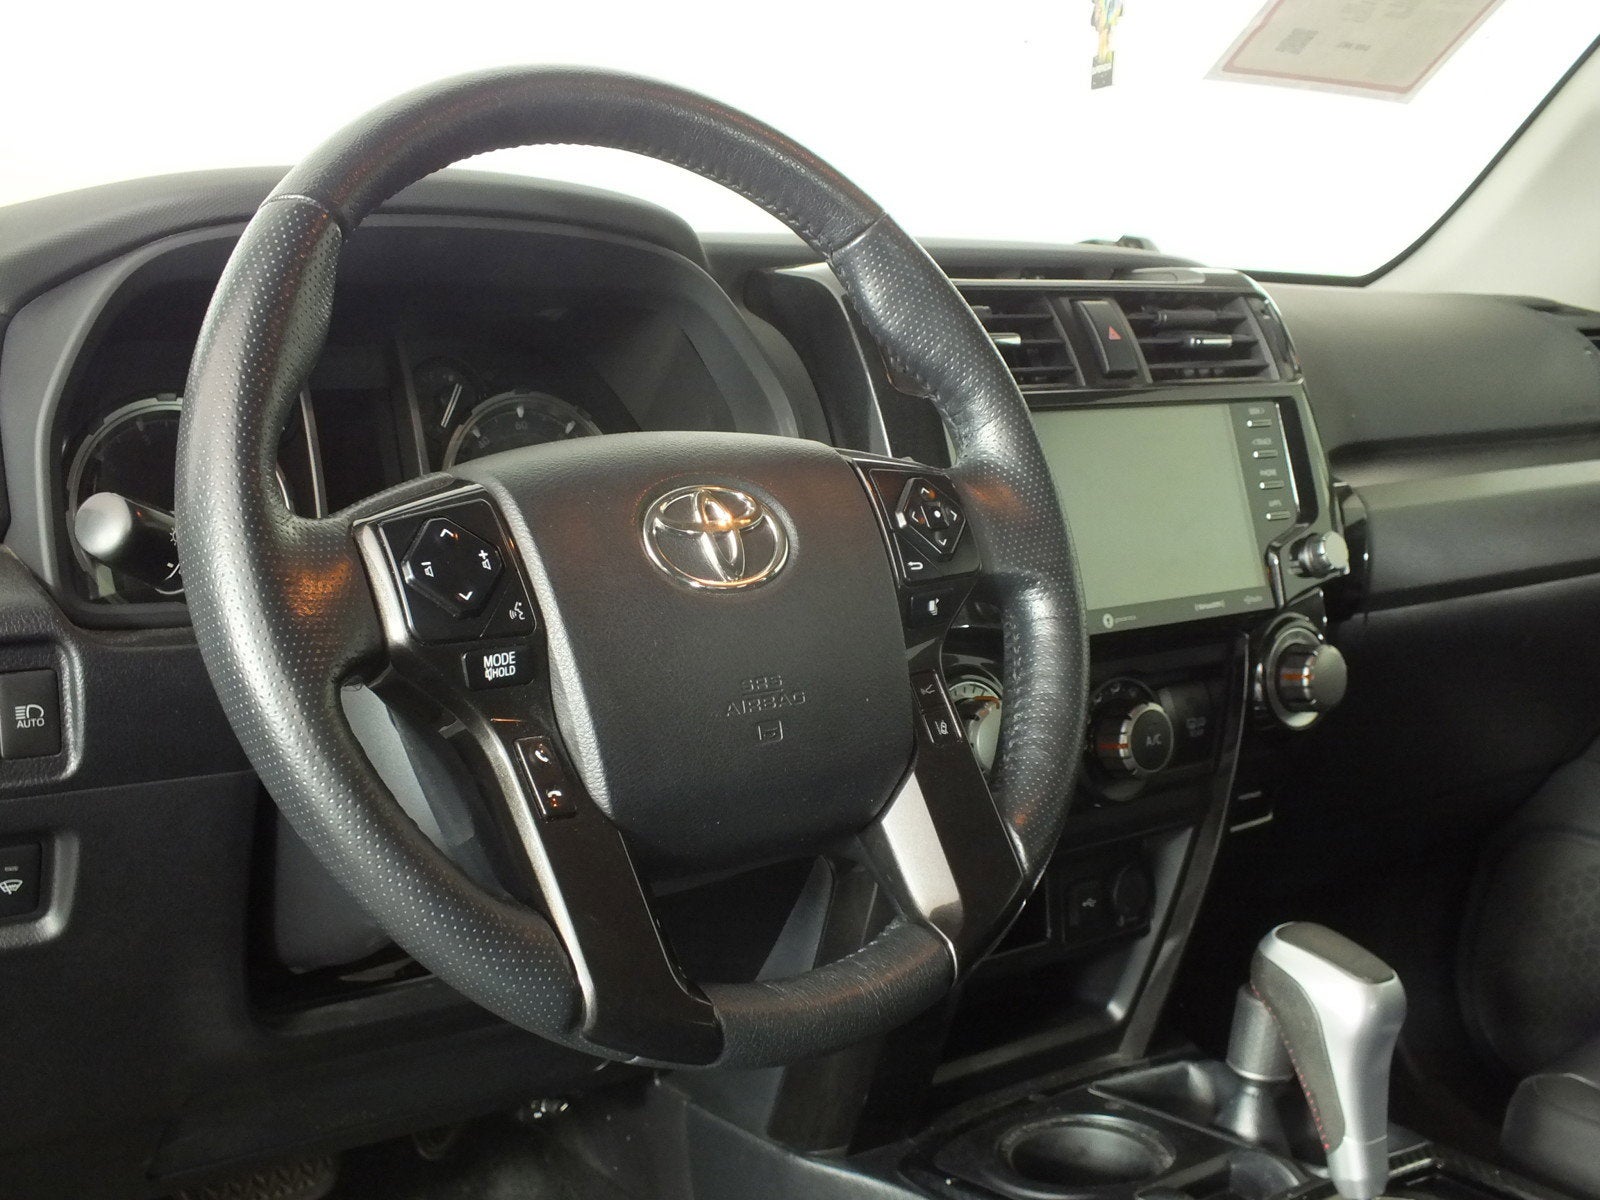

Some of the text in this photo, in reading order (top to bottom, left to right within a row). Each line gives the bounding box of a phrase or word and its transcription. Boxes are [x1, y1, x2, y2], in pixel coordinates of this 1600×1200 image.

[483, 651, 516, 668] MODE
[492, 665, 516, 678] HOLD
[726, 691, 806, 717] AIRBAG
[16, 717, 45, 729] AUTO
